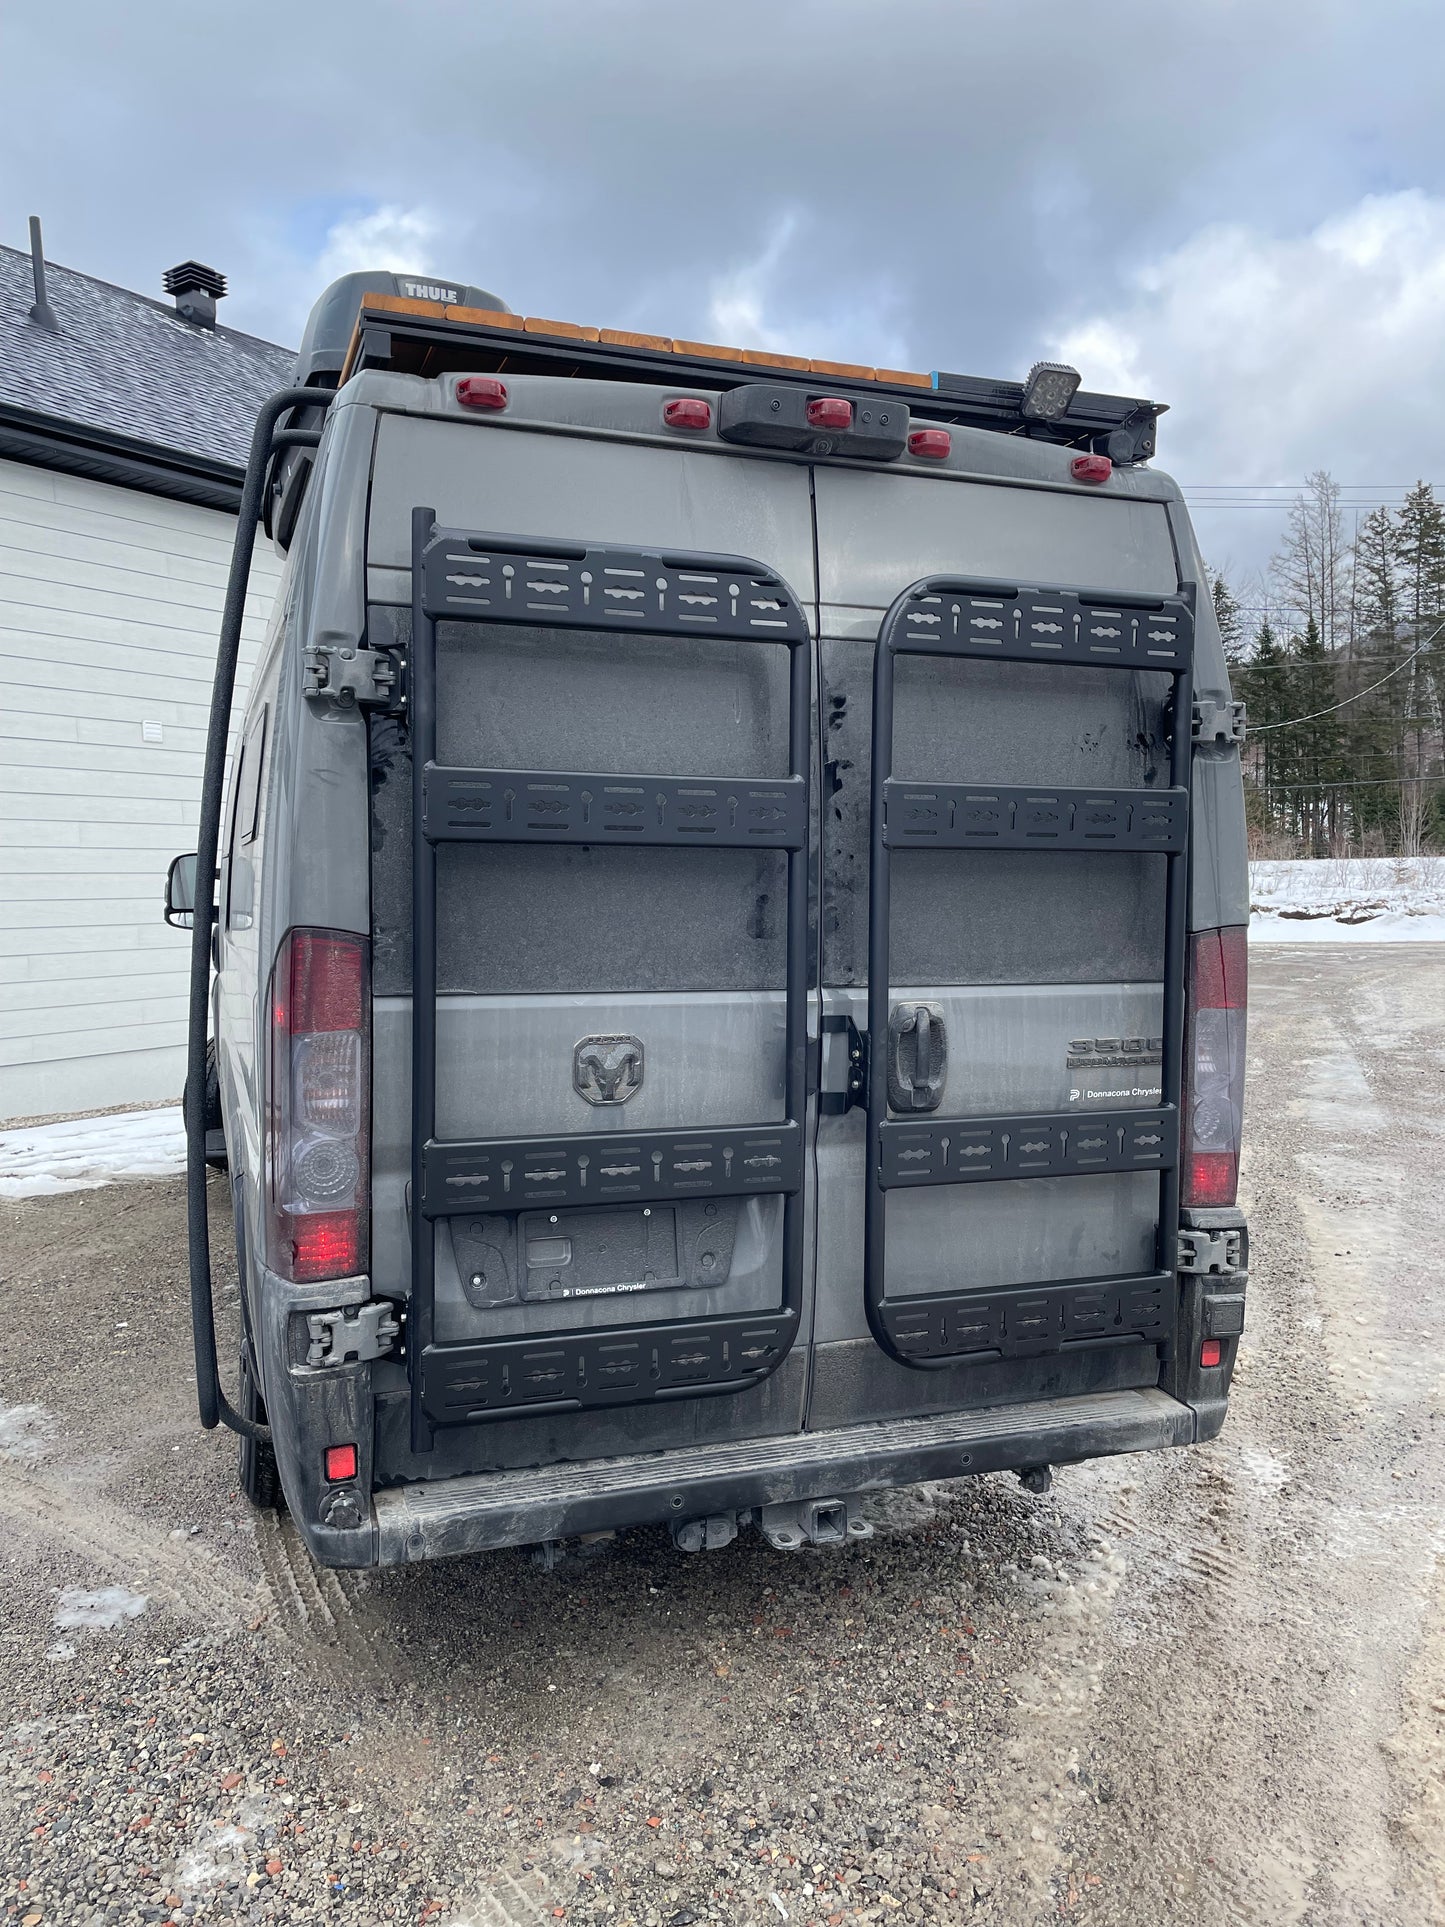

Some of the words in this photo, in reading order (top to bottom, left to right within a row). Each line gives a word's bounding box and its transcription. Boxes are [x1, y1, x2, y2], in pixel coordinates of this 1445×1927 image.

[405, 283, 457, 303] THULE
[1087, 1089, 1130, 1098] Donnacona
[575, 1286, 616, 1296] Donnacona
[617, 1283, 646, 1291] Chrysler
